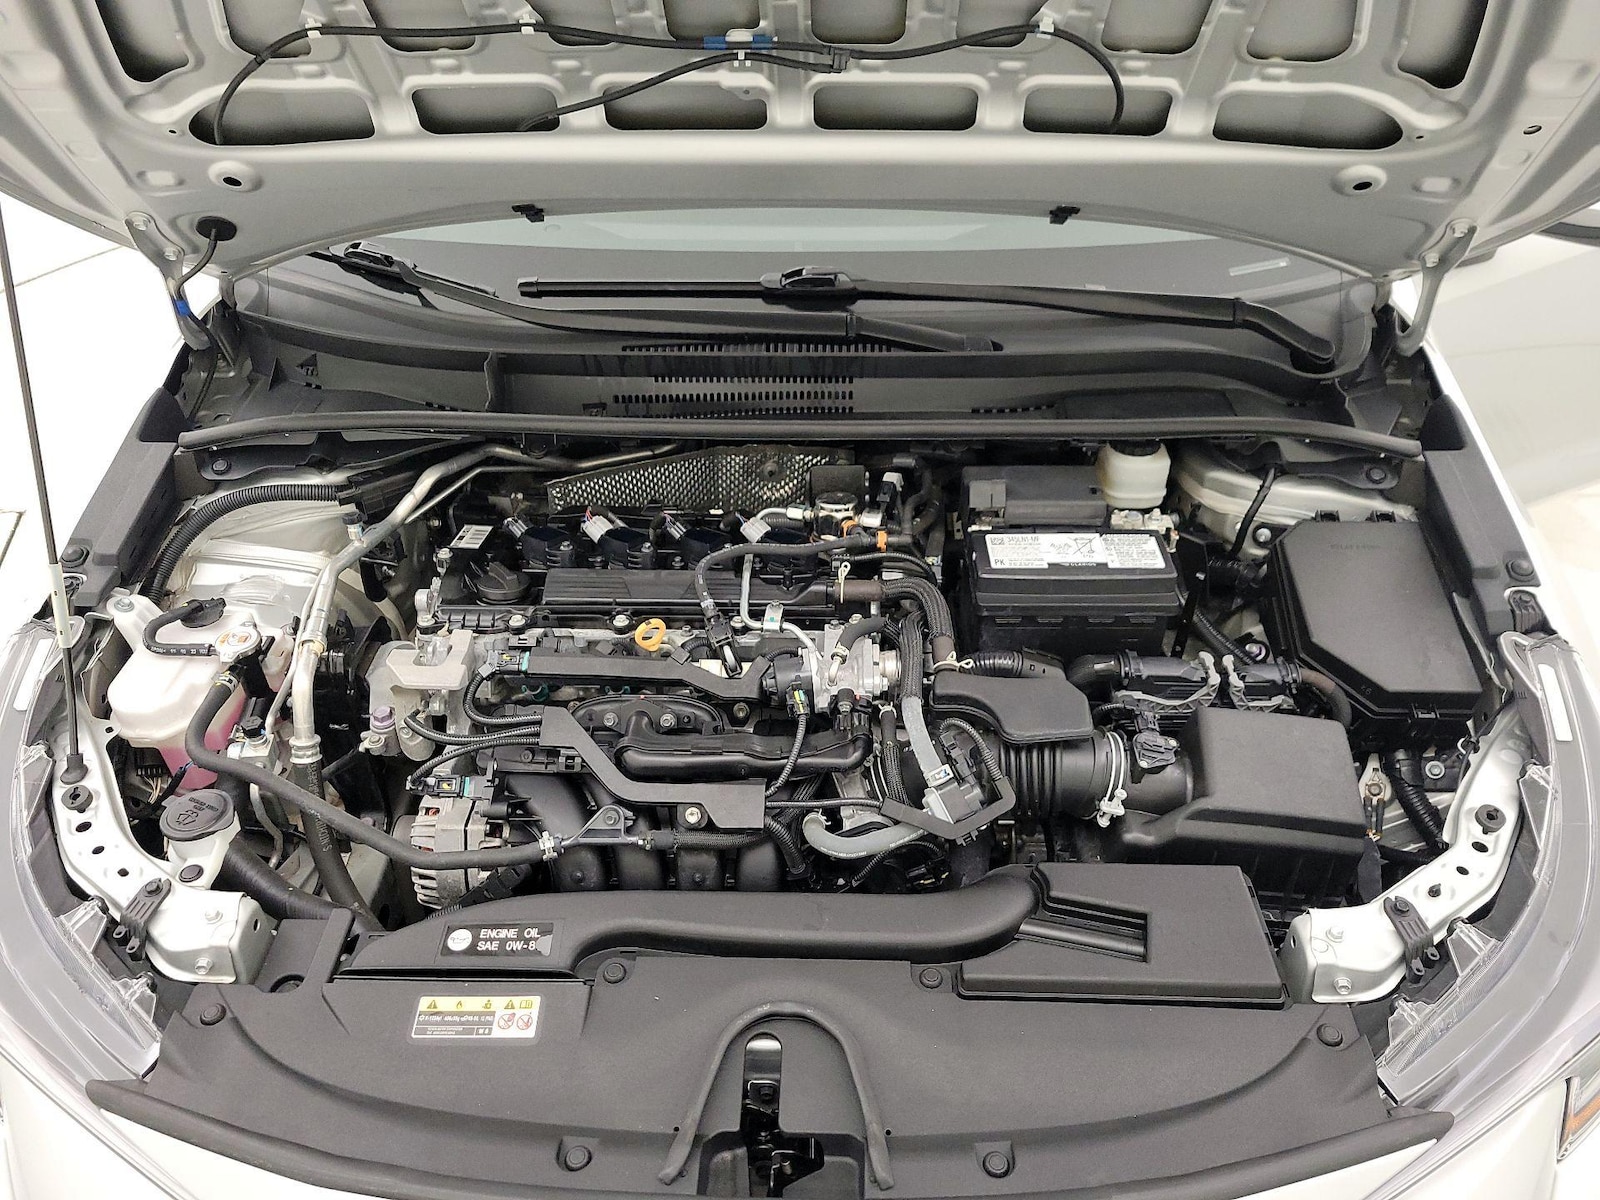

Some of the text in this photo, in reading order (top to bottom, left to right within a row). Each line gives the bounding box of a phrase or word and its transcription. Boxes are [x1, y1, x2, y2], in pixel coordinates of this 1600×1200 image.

[994, 558, 1006, 566] PK
[479, 927, 541, 939] ENGINE OIL
[476, 940, 536, 951] SAE 0W-8
